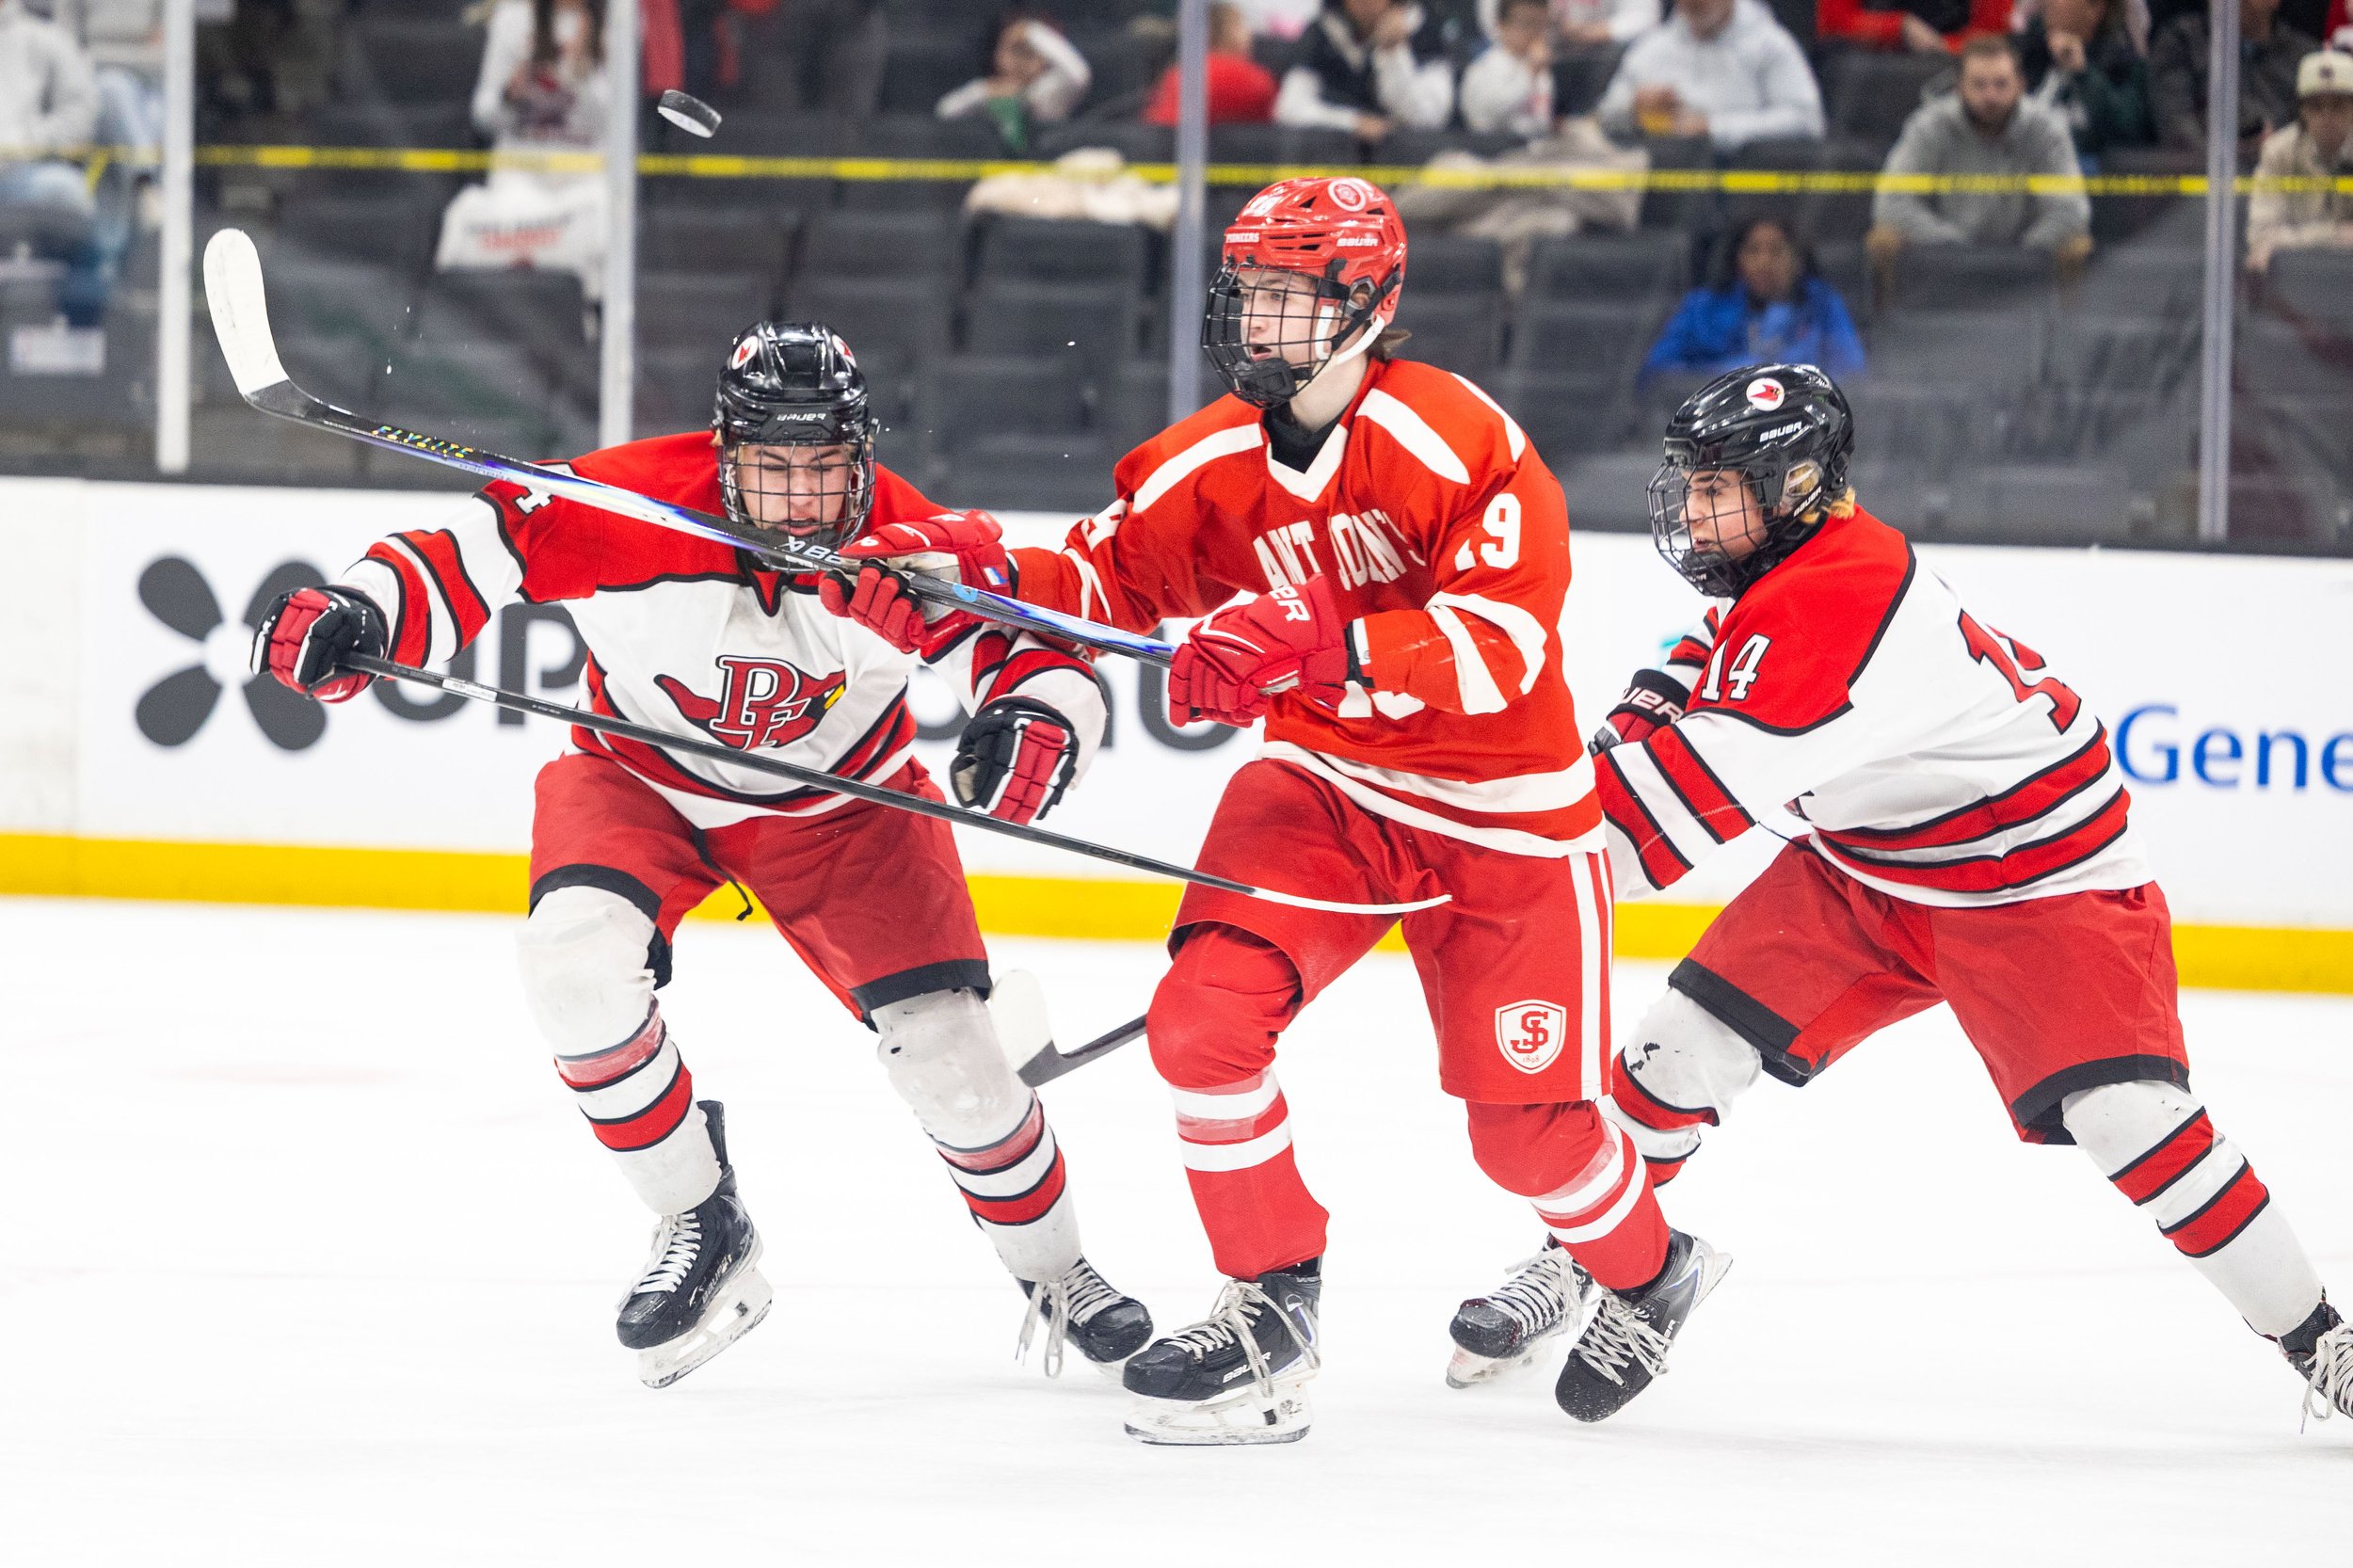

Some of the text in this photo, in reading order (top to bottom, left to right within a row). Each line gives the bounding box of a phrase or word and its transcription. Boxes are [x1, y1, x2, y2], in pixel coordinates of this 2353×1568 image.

[1337, 237, 1378, 247] BAUER
[1760, 422, 1802, 442] BAUER
[1793, 486, 1822, 518] BAUER
[1700, 632, 1773, 702] 14
